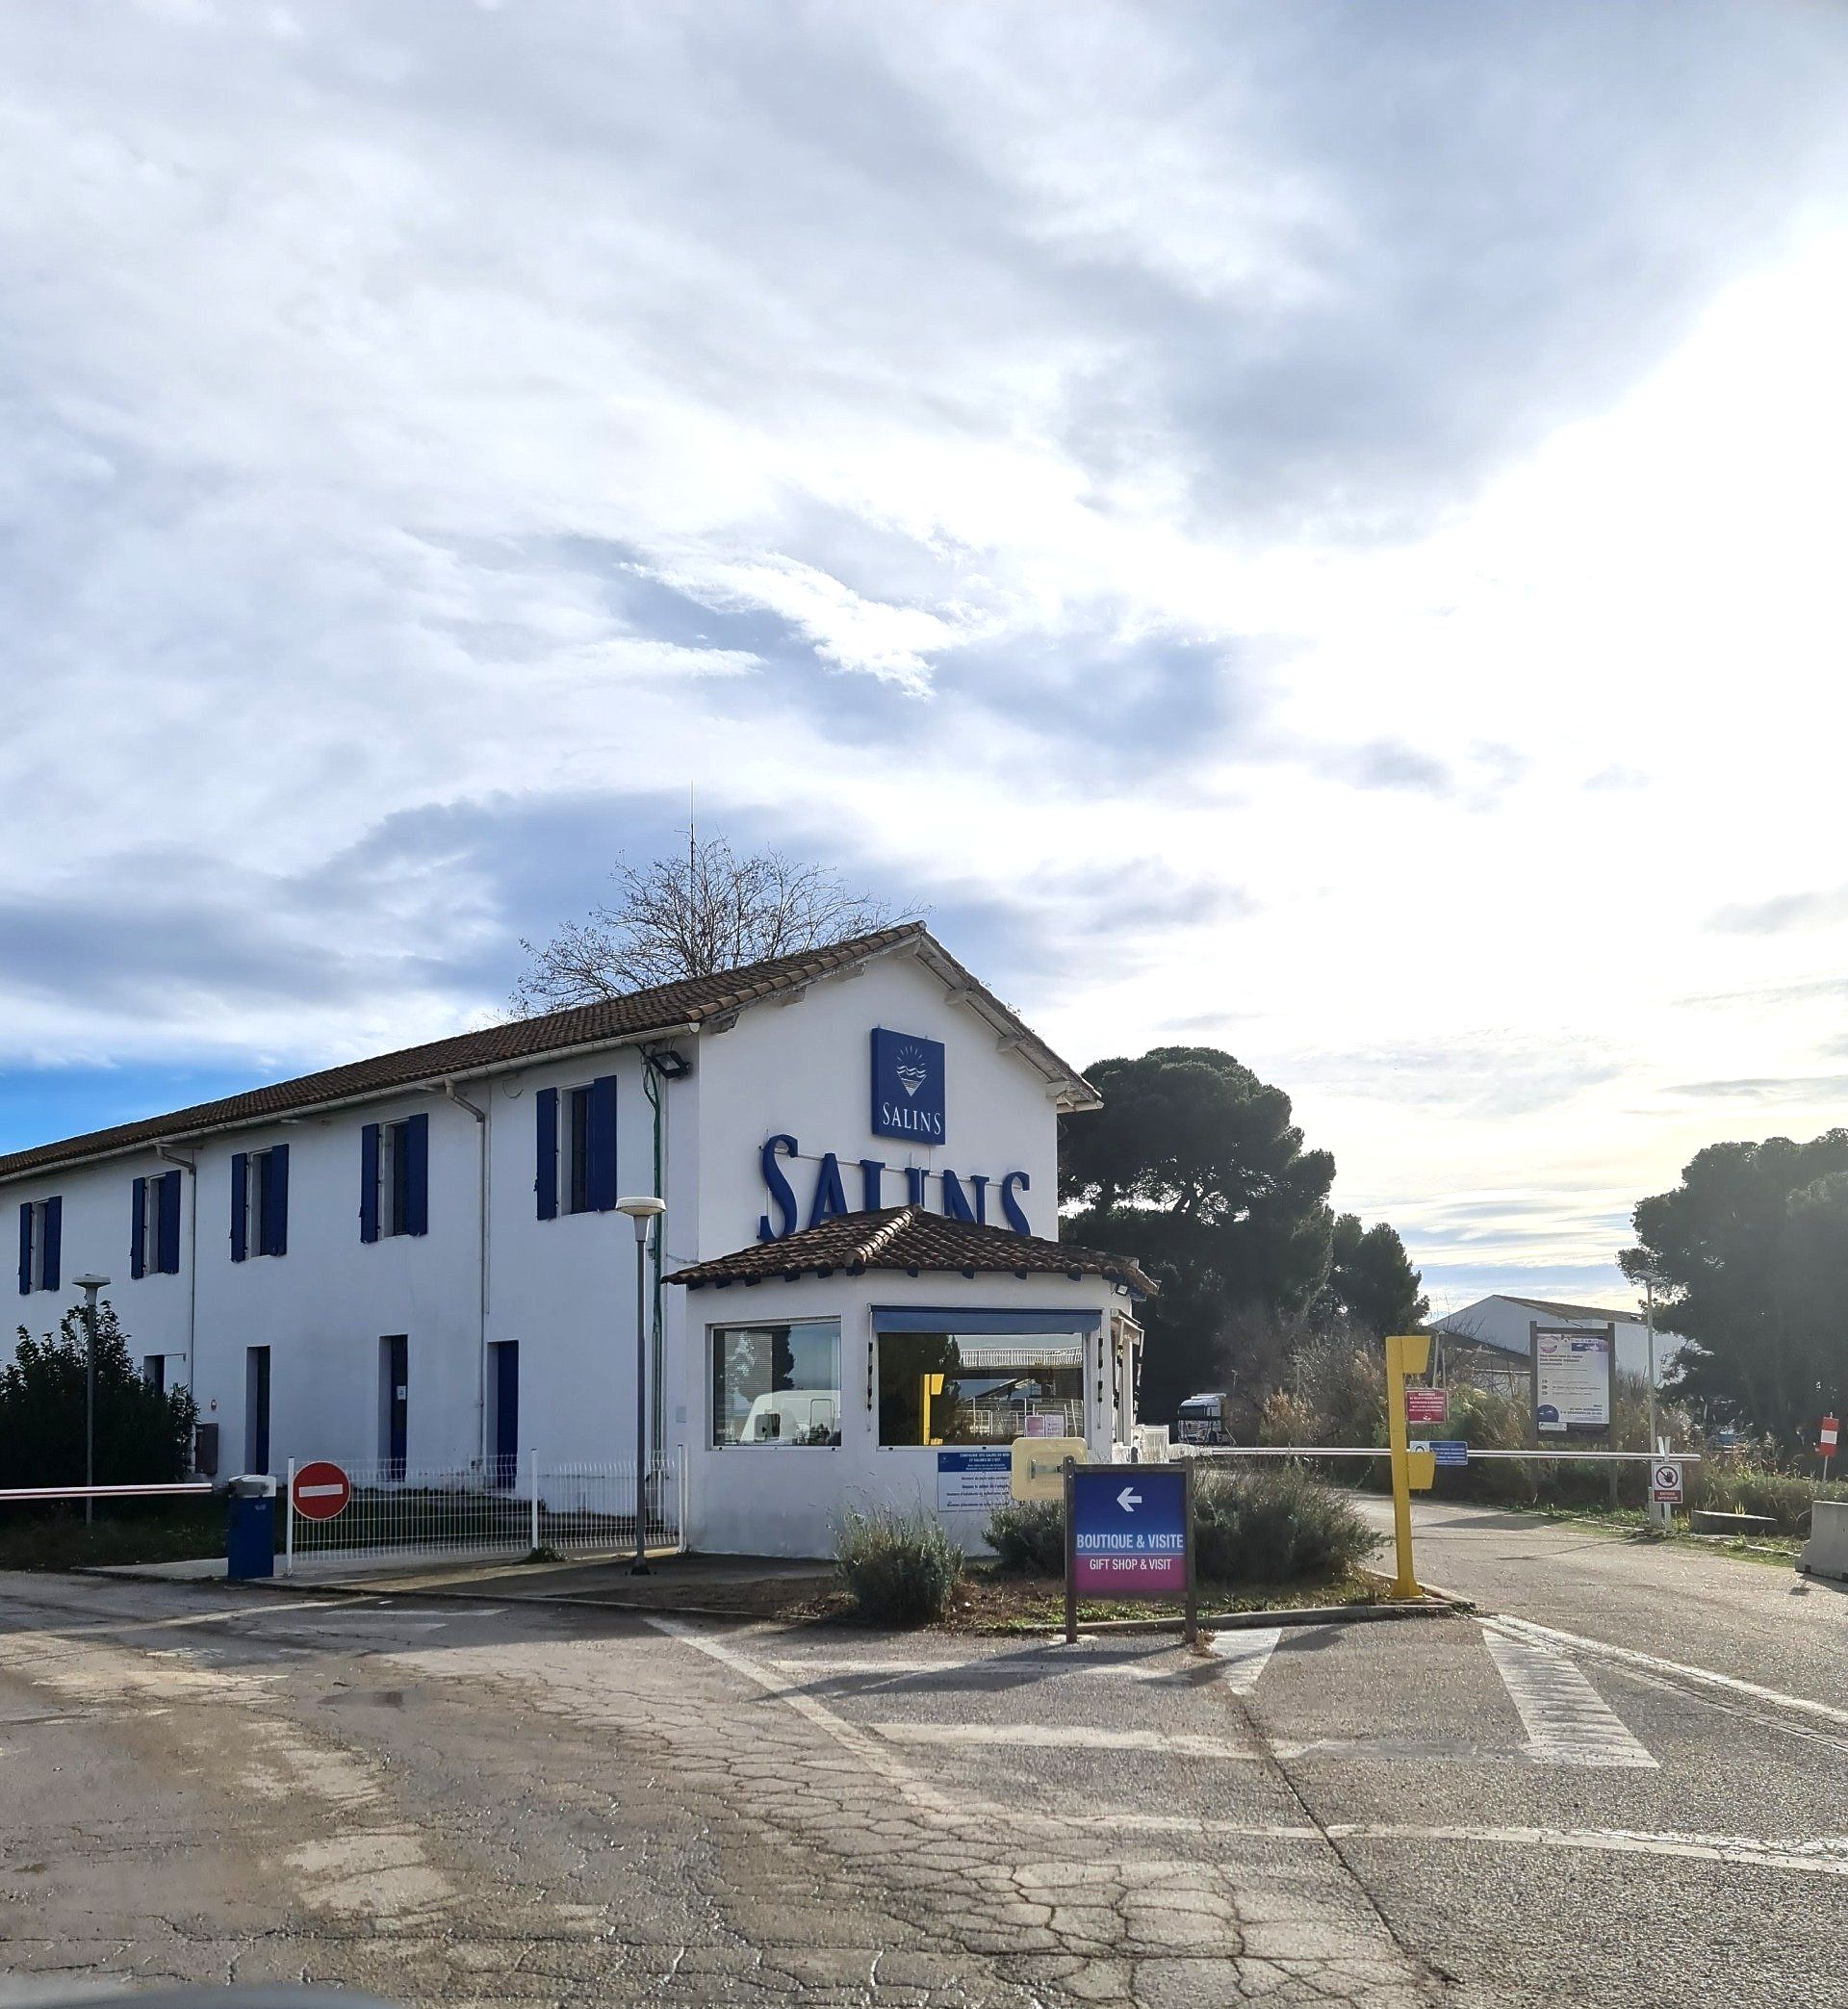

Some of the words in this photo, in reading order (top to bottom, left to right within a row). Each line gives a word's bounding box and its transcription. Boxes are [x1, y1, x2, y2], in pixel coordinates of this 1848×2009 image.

[883, 1101, 941, 1135] SALINS
[1076, 1533, 1134, 1549] BOUTIQUE
[1136, 1533, 1145, 1549] &
[1147, 1533, 1184, 1549] VISITE
[1090, 1558, 1110, 1570] GIFT
[1112, 1558, 1138, 1570] SHOP
[1140, 1558, 1147, 1570] &
[1148, 1558, 1172, 1570] VISIT
